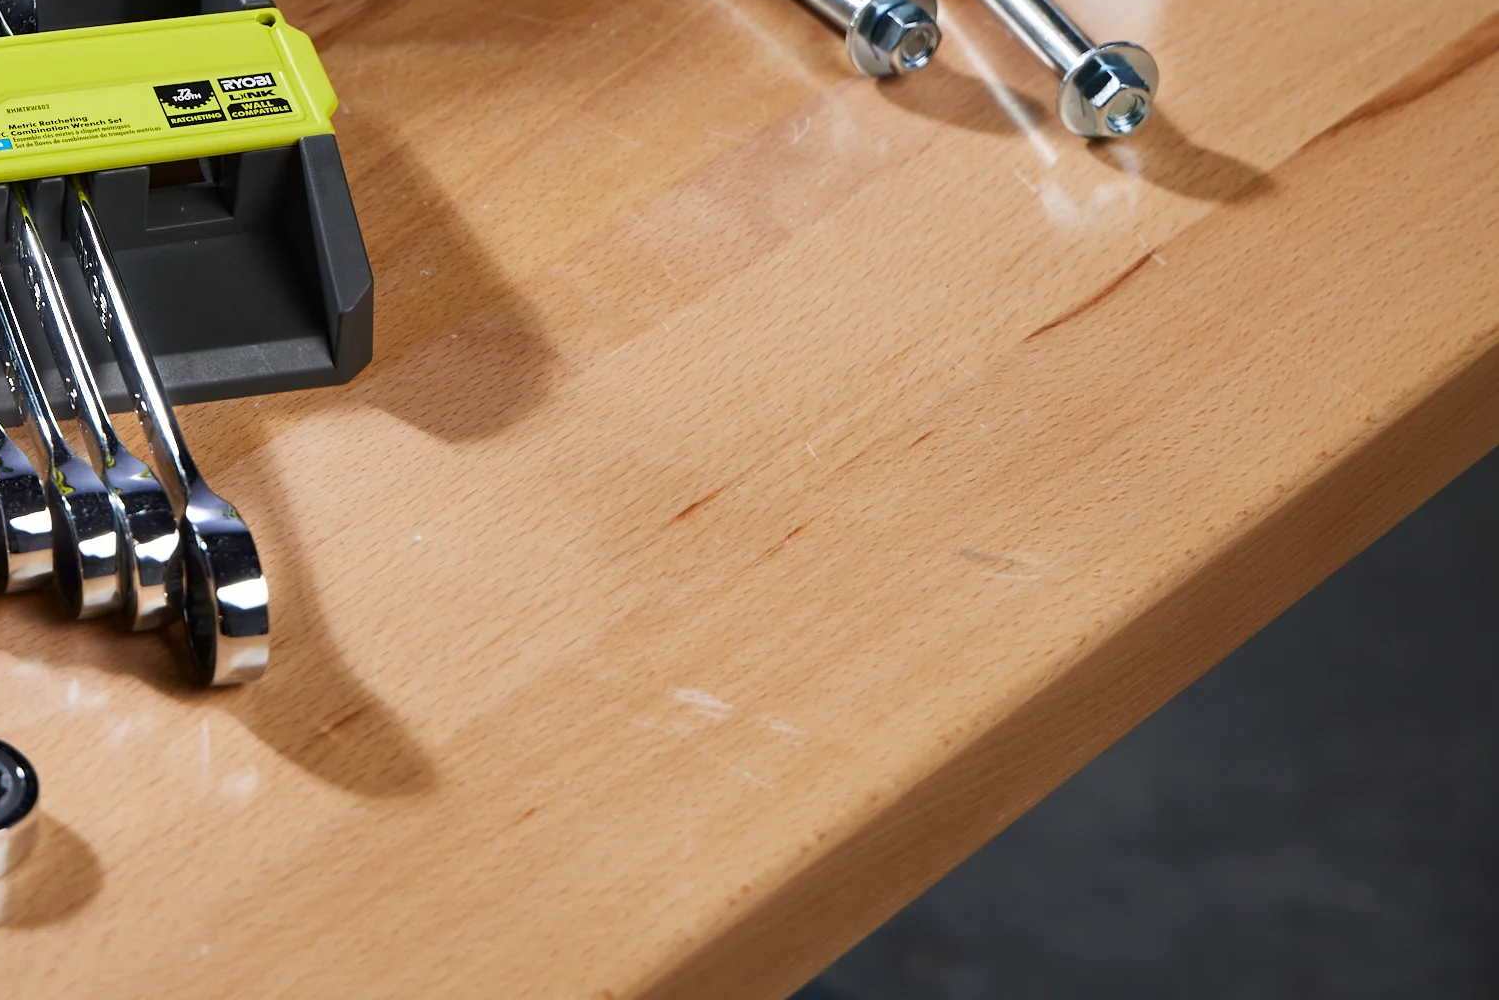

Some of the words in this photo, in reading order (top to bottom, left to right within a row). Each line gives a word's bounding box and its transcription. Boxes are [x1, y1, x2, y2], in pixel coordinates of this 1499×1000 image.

[220, 75, 273, 91] RYOBI
[172, 92, 202, 102] TOOTH
[177, 88, 191, 96] 72
[228, 89, 276, 101] LINK
[6, 103, 50, 114] RHMTRW802
[241, 100, 275, 110] WALL
[231, 105, 290, 118] COMPATIBLE
[8, 122, 37, 130] Metric
[39, 116, 88, 126] Ratcheting
[170, 112, 222, 124] RATCHETING
[10, 126, 70, 136] Combination
[71, 120, 106, 129] Wrench
[108, 117, 122, 125] Set
[13, 134, 41, 143] Ensemble
[80, 127, 100, 135] cliquet
